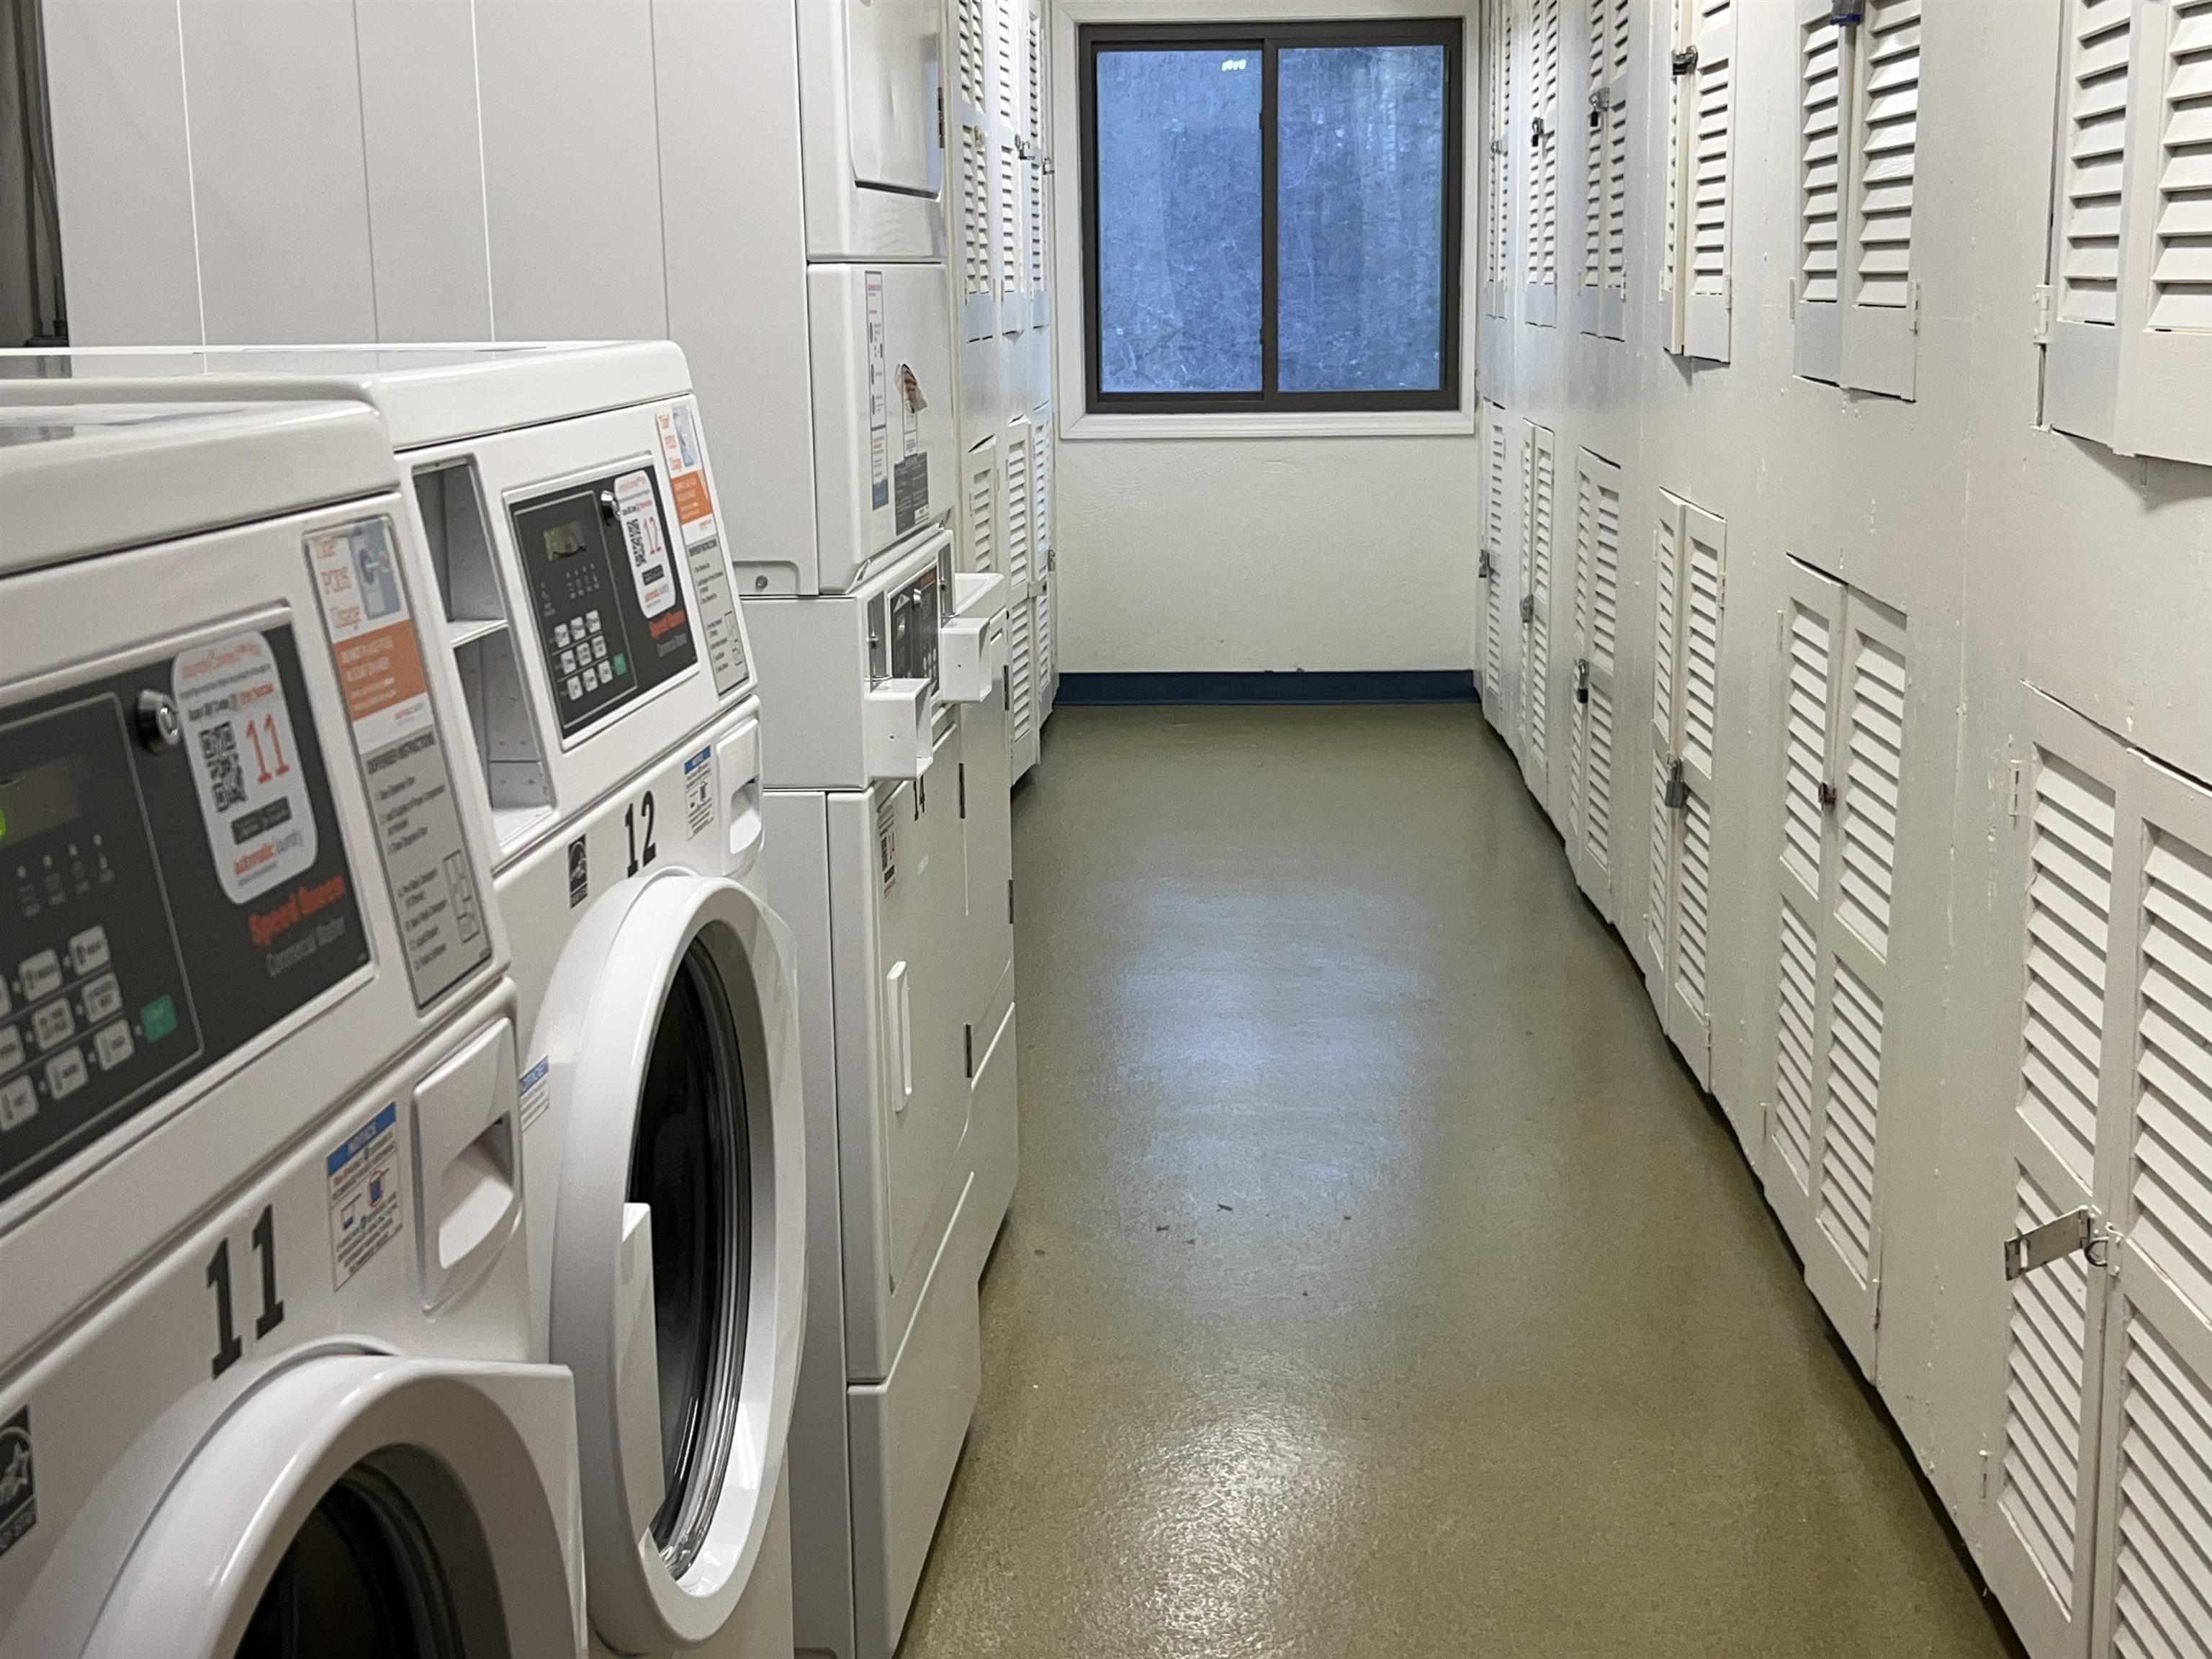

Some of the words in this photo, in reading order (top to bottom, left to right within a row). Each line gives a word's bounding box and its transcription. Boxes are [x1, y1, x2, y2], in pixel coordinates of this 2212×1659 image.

[643, 516, 661, 555] 12
[246, 714, 289, 783] 11
[624, 790, 657, 879] 12
[206, 1203, 284, 1381] 11
